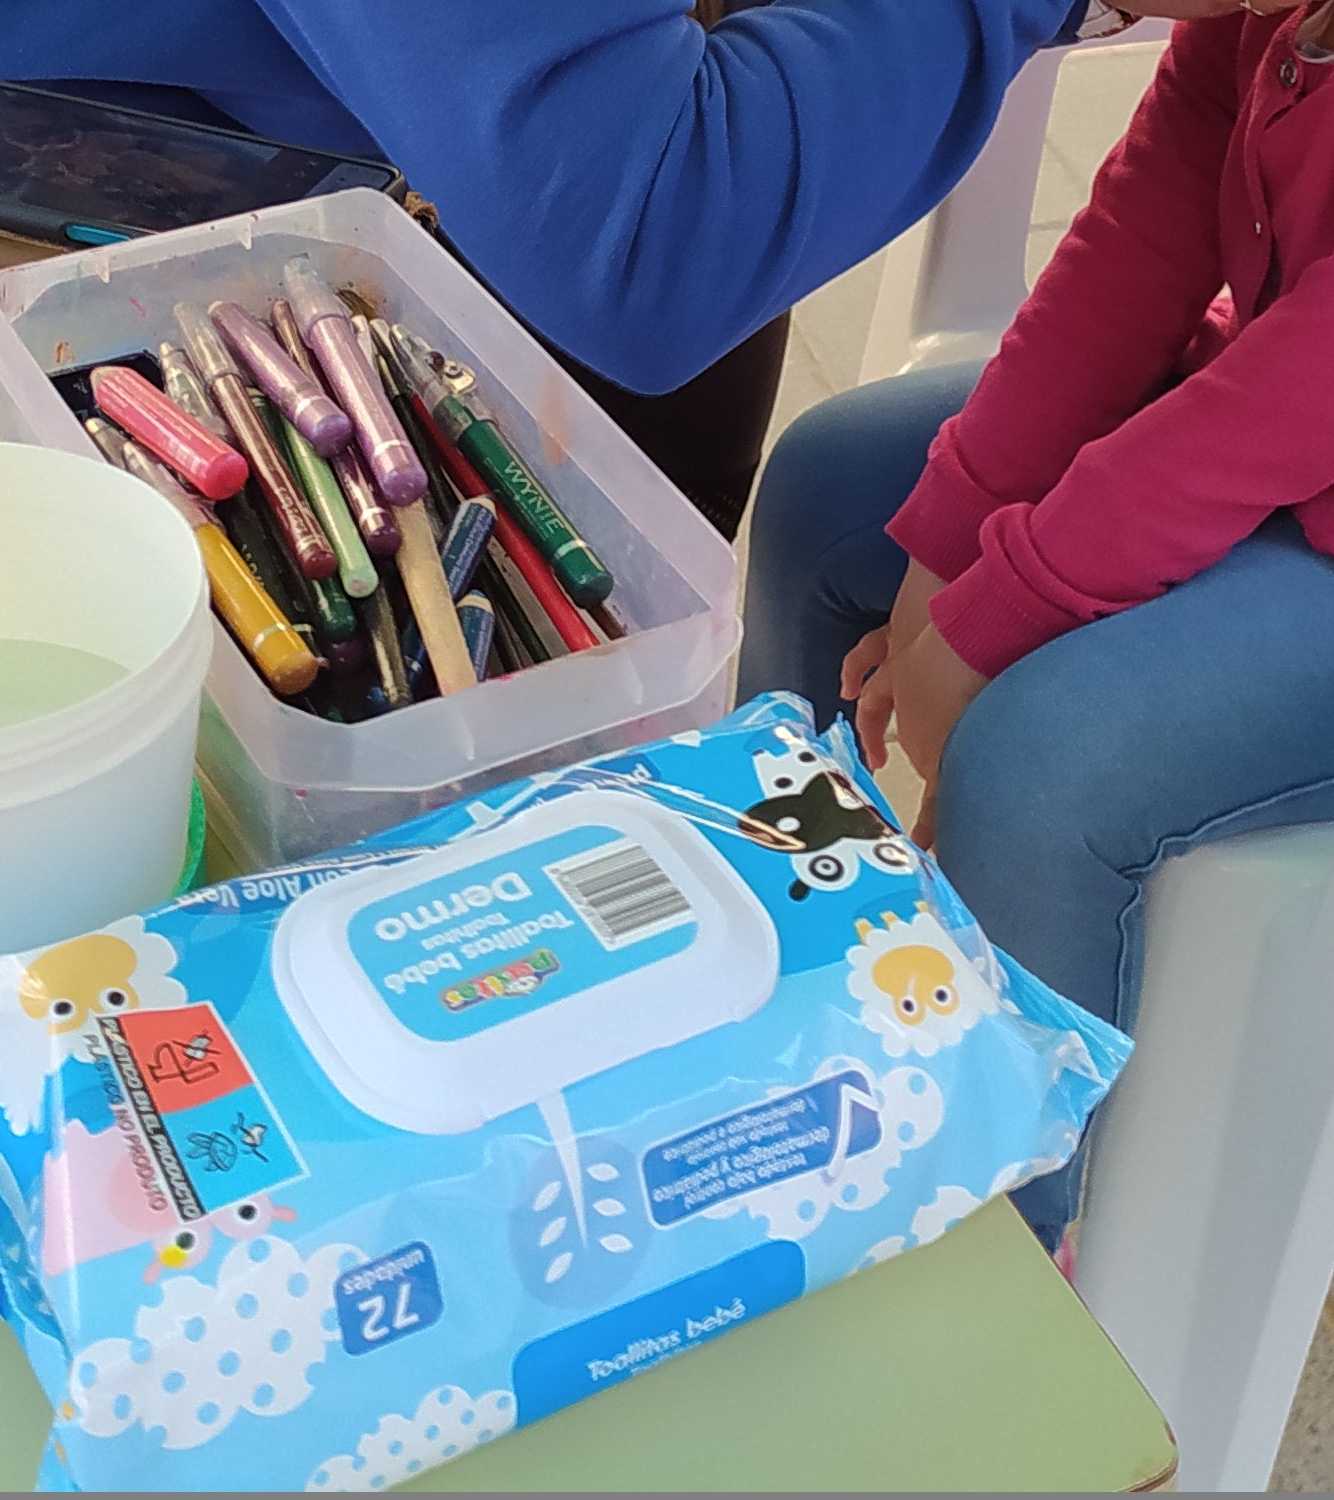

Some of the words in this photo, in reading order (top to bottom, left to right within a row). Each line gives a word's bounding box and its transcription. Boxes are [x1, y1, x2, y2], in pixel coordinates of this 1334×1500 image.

[504, 460, 565, 535] WYNIE
[239, 874, 298, 902] Aloe
[374, 871, 531, 942] Dermo
[421, 913, 506, 950] Toalhitas
[460, 911, 571, 960] Toallitas
[383, 951, 461, 995] bebé
[131, 1085, 154, 1110] EN
[141, 1111, 161, 1133] EL
[113, 1107, 135, 1130] NO
[124, 1133, 168, 1211] PRODUTO
[148, 1132, 203, 1219] PRODUCTO
[727, 1170, 755, 1190] bajo
[756, 1153, 807, 1179] testado
[683, 1180, 725, 1210] control
[342, 1248, 424, 1295] unidades
[356, 1280, 420, 1341] 72
[586, 1328, 681, 1380] Toallitas
[682, 1296, 747, 1338] bebé
